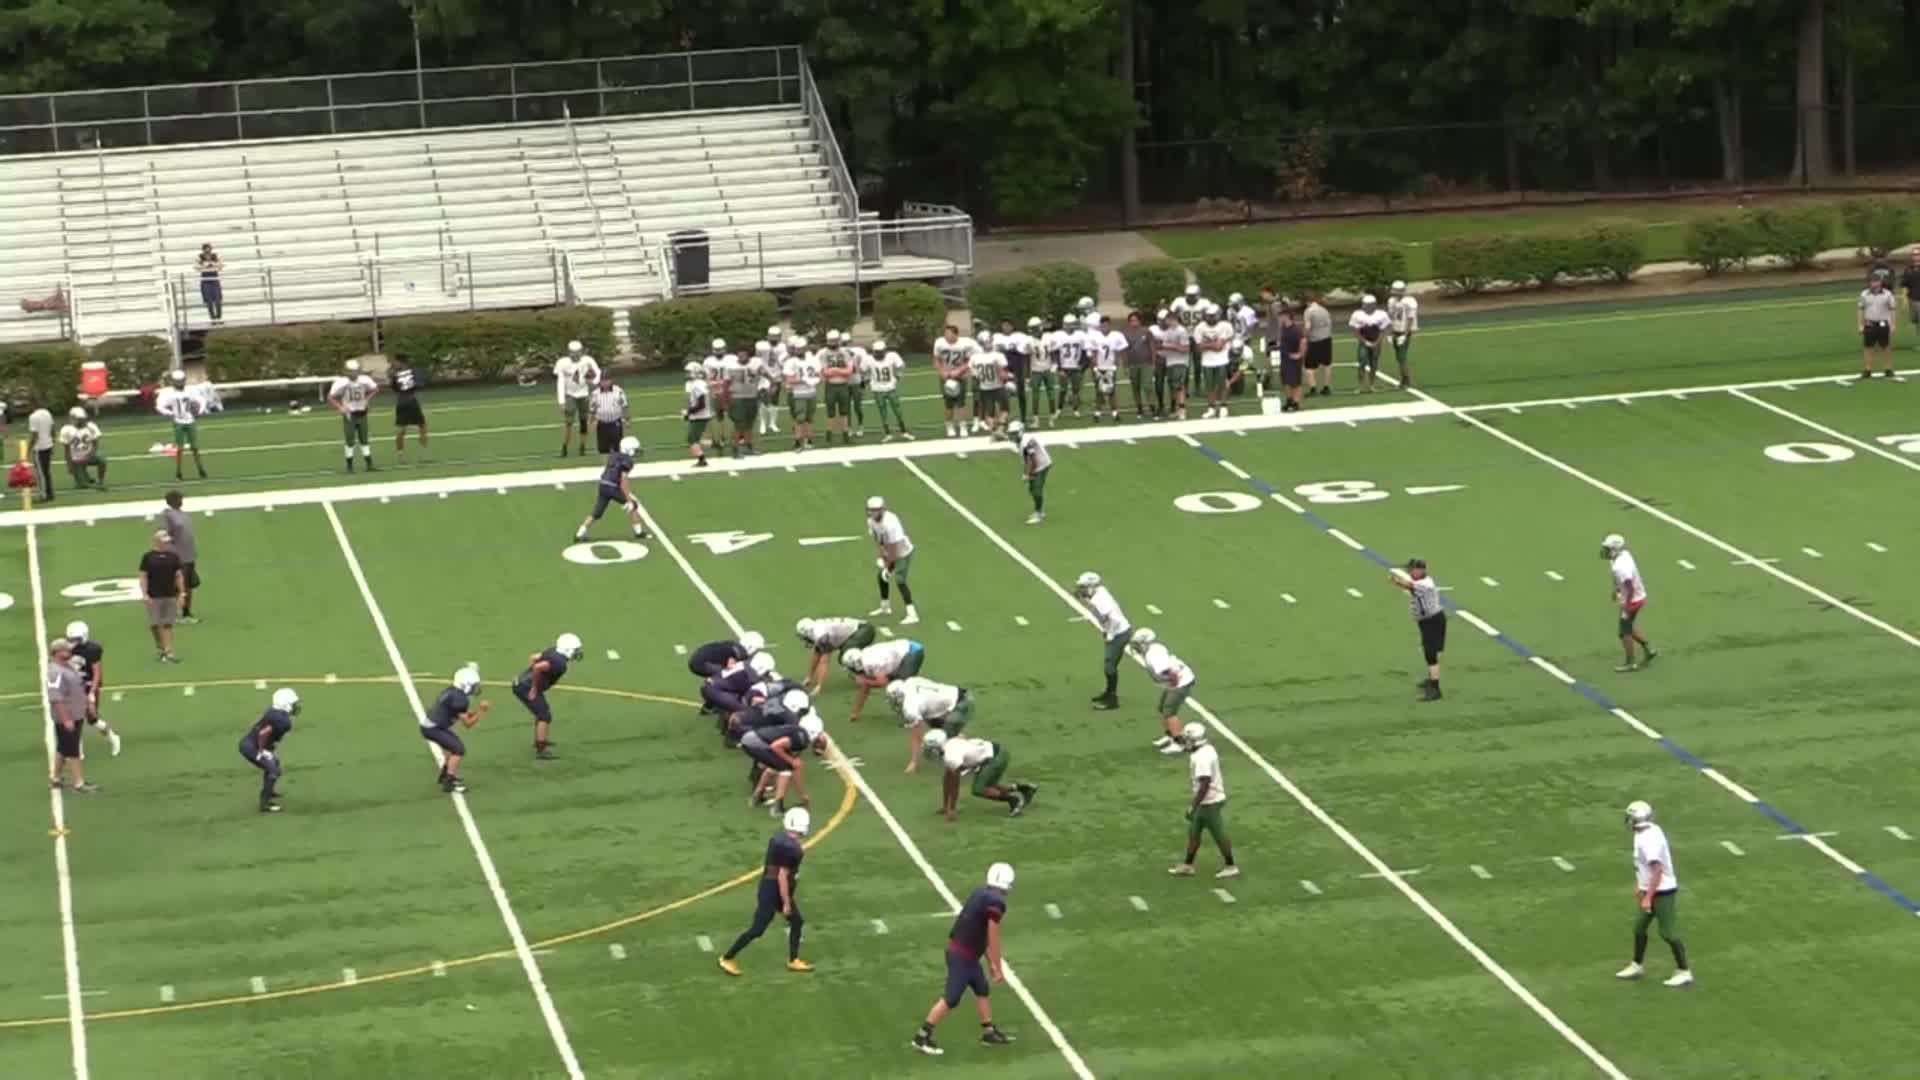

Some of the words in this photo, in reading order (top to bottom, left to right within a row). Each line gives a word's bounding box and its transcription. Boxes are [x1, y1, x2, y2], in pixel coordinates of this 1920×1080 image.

[1061, 342, 1081, 359] 37
[873, 366, 892, 382] 19
[975, 363, 995, 382] 30
